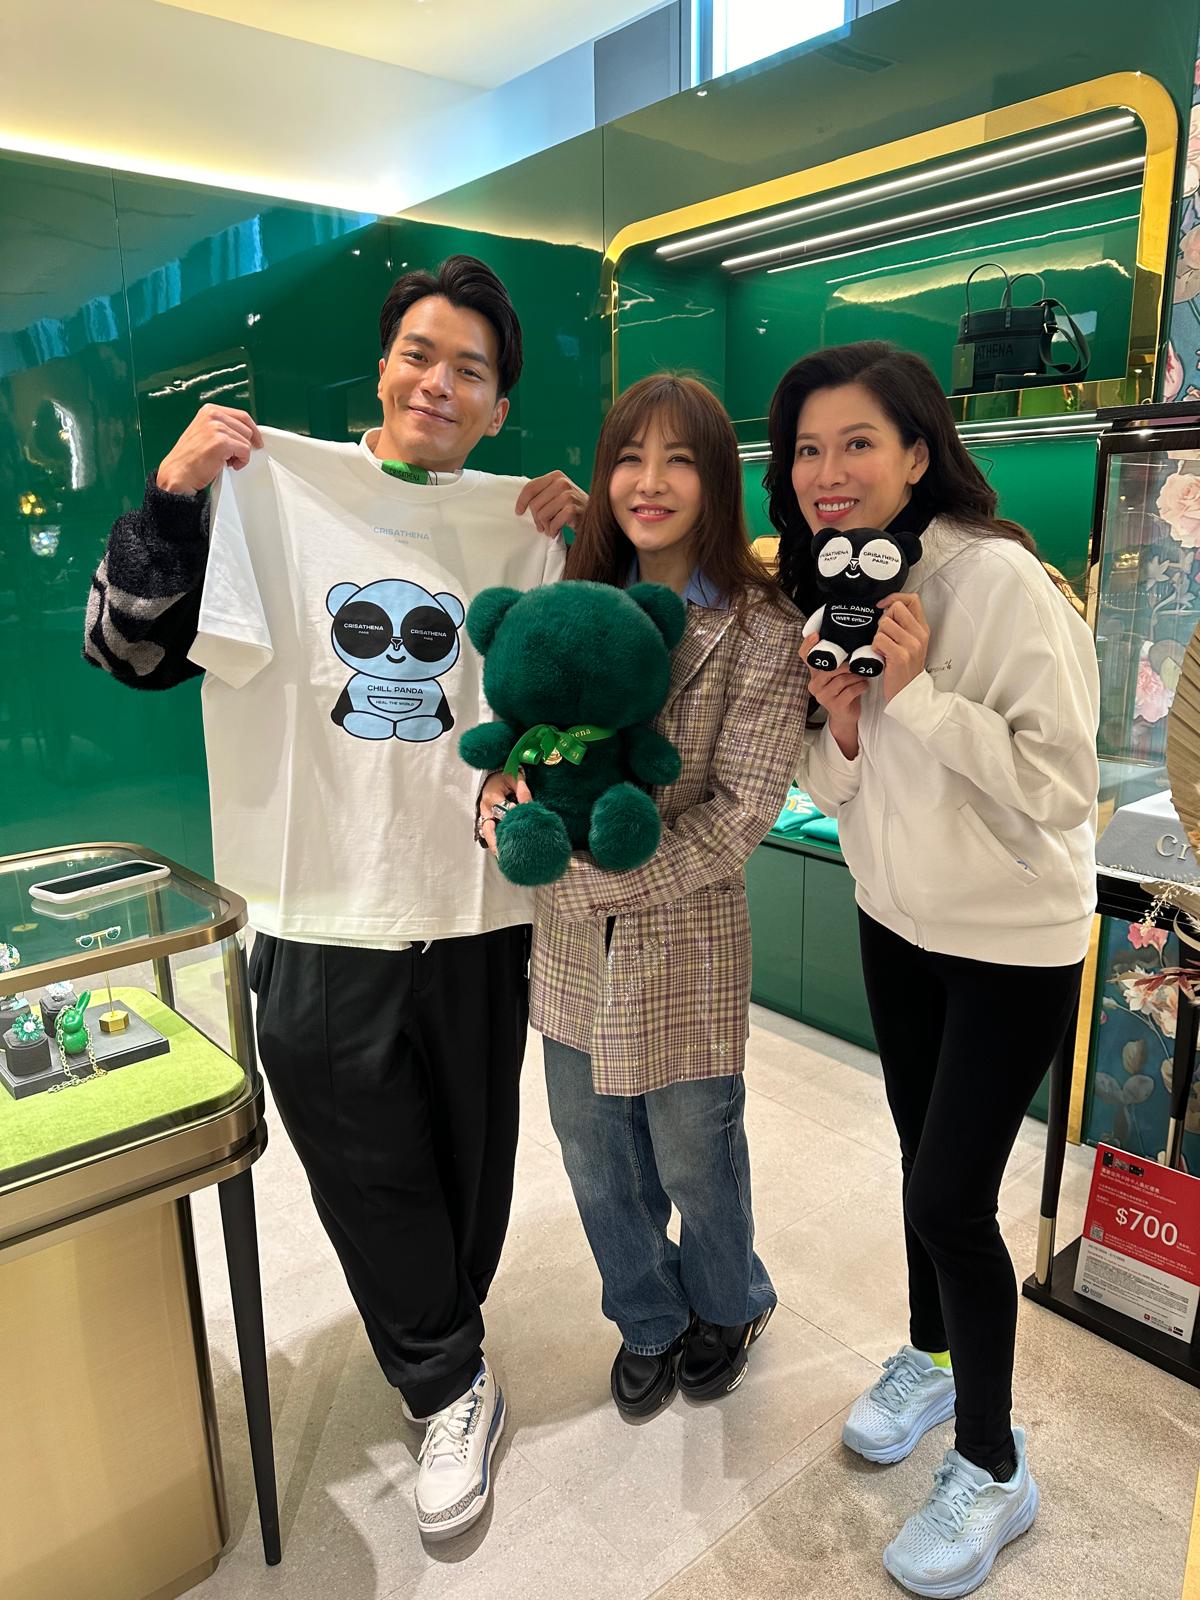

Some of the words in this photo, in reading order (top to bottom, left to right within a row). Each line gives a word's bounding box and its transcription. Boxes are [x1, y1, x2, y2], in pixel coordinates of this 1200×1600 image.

[976, 343, 1014, 361] ATHENA
[373, 526, 430, 541] CRISATHENA
[871, 558, 889, 566] PARIS
[850, 605, 875, 614] PANDA
[343, 622, 384, 631] CRISATHENA
[410, 628, 447, 637] CRISATHENA
[815, 657, 829, 667] 20
[858, 666, 873, 675] 24
[367, 684, 392, 693] CHILL
[394, 686, 424, 695] PANDA
[1156, 834, 1191, 861] Cr
[1115, 1207, 1178, 1247] $700
